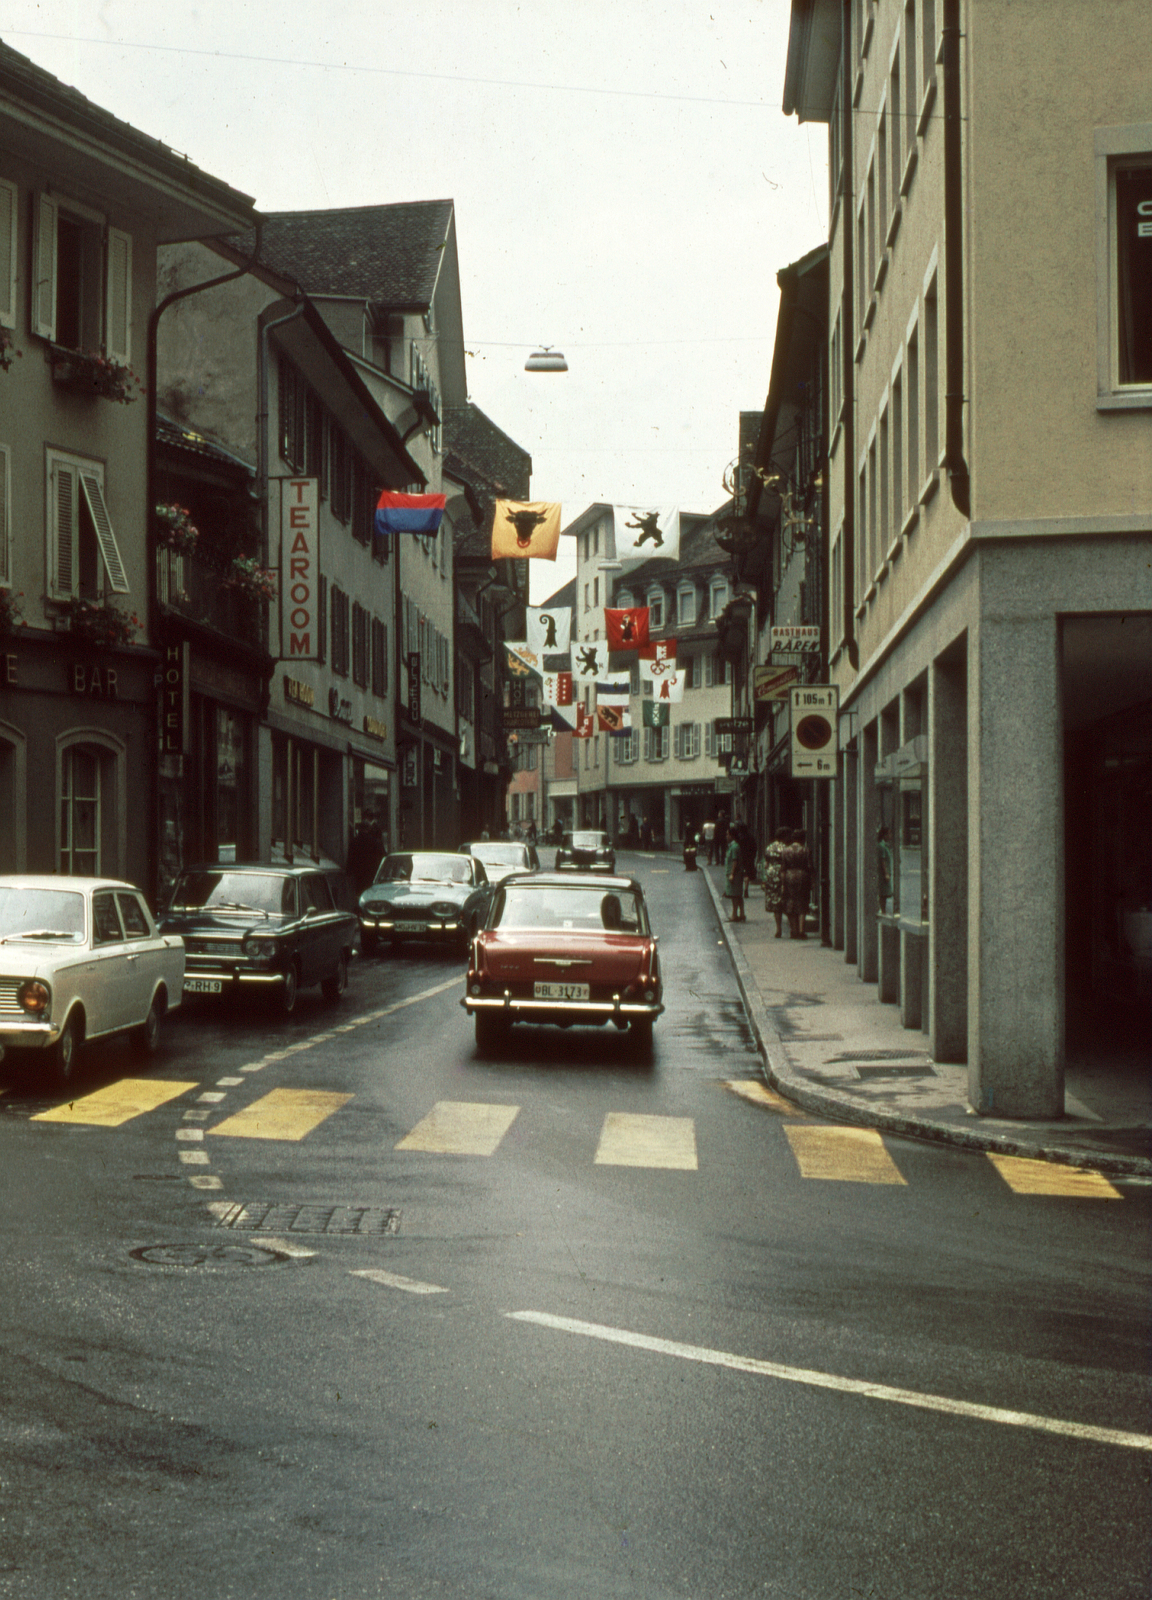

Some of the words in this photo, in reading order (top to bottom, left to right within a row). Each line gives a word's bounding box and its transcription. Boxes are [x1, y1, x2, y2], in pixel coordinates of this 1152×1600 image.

[290, 481, 310, 656] TEAROOM
[75, 664, 118, 695] BAR
[167, 647, 179, 749] HOTEL
[410, 655, 419, 721] coiffure
